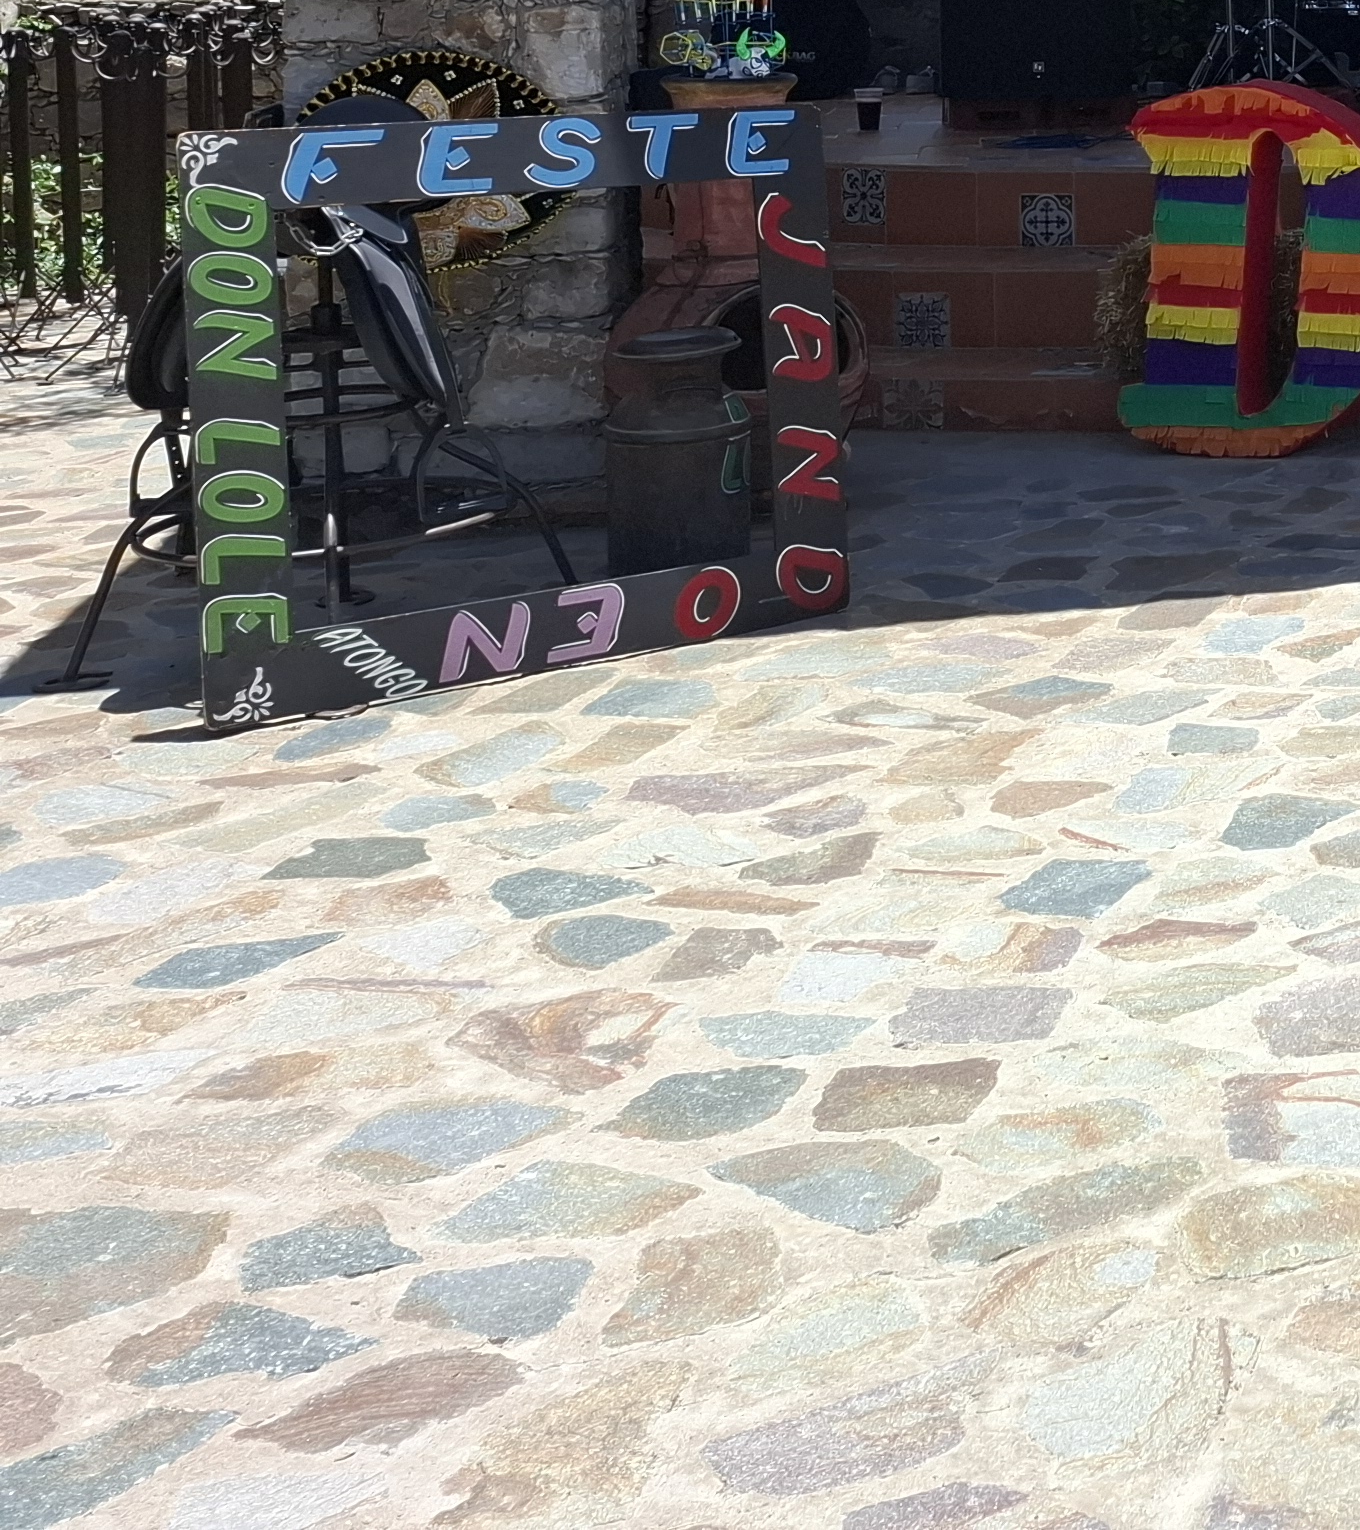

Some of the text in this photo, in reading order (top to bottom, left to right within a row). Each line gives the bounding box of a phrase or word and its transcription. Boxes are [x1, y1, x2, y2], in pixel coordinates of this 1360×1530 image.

[281, 109, 795, 205] FESTE
[186, 184, 292, 656] DON LOLE
[312, 628, 429, 698] ATONGO
